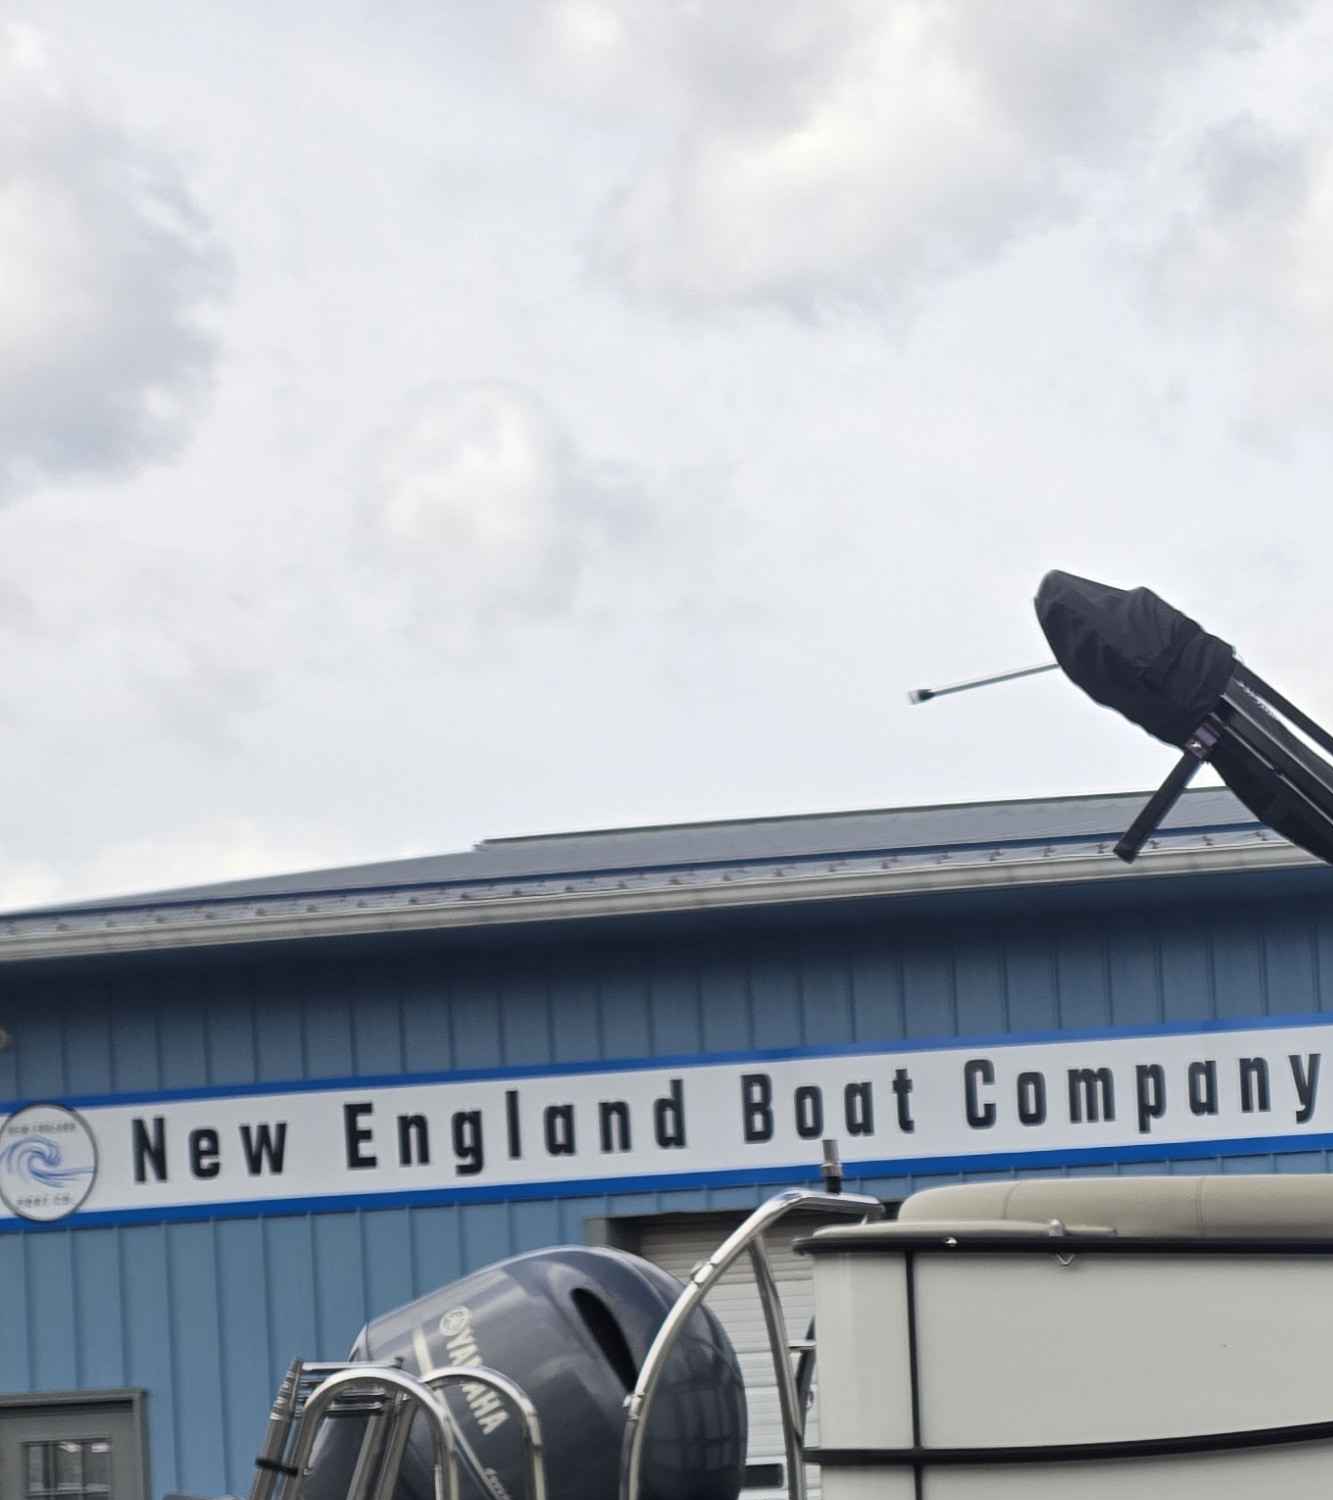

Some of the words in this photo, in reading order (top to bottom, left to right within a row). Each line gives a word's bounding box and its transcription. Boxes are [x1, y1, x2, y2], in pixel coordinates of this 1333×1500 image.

[131, 1115, 288, 1184] New
[342, 1078, 688, 1176] England
[740, 1067, 916, 1144] Boat
[963, 1052, 1322, 1134] Company
